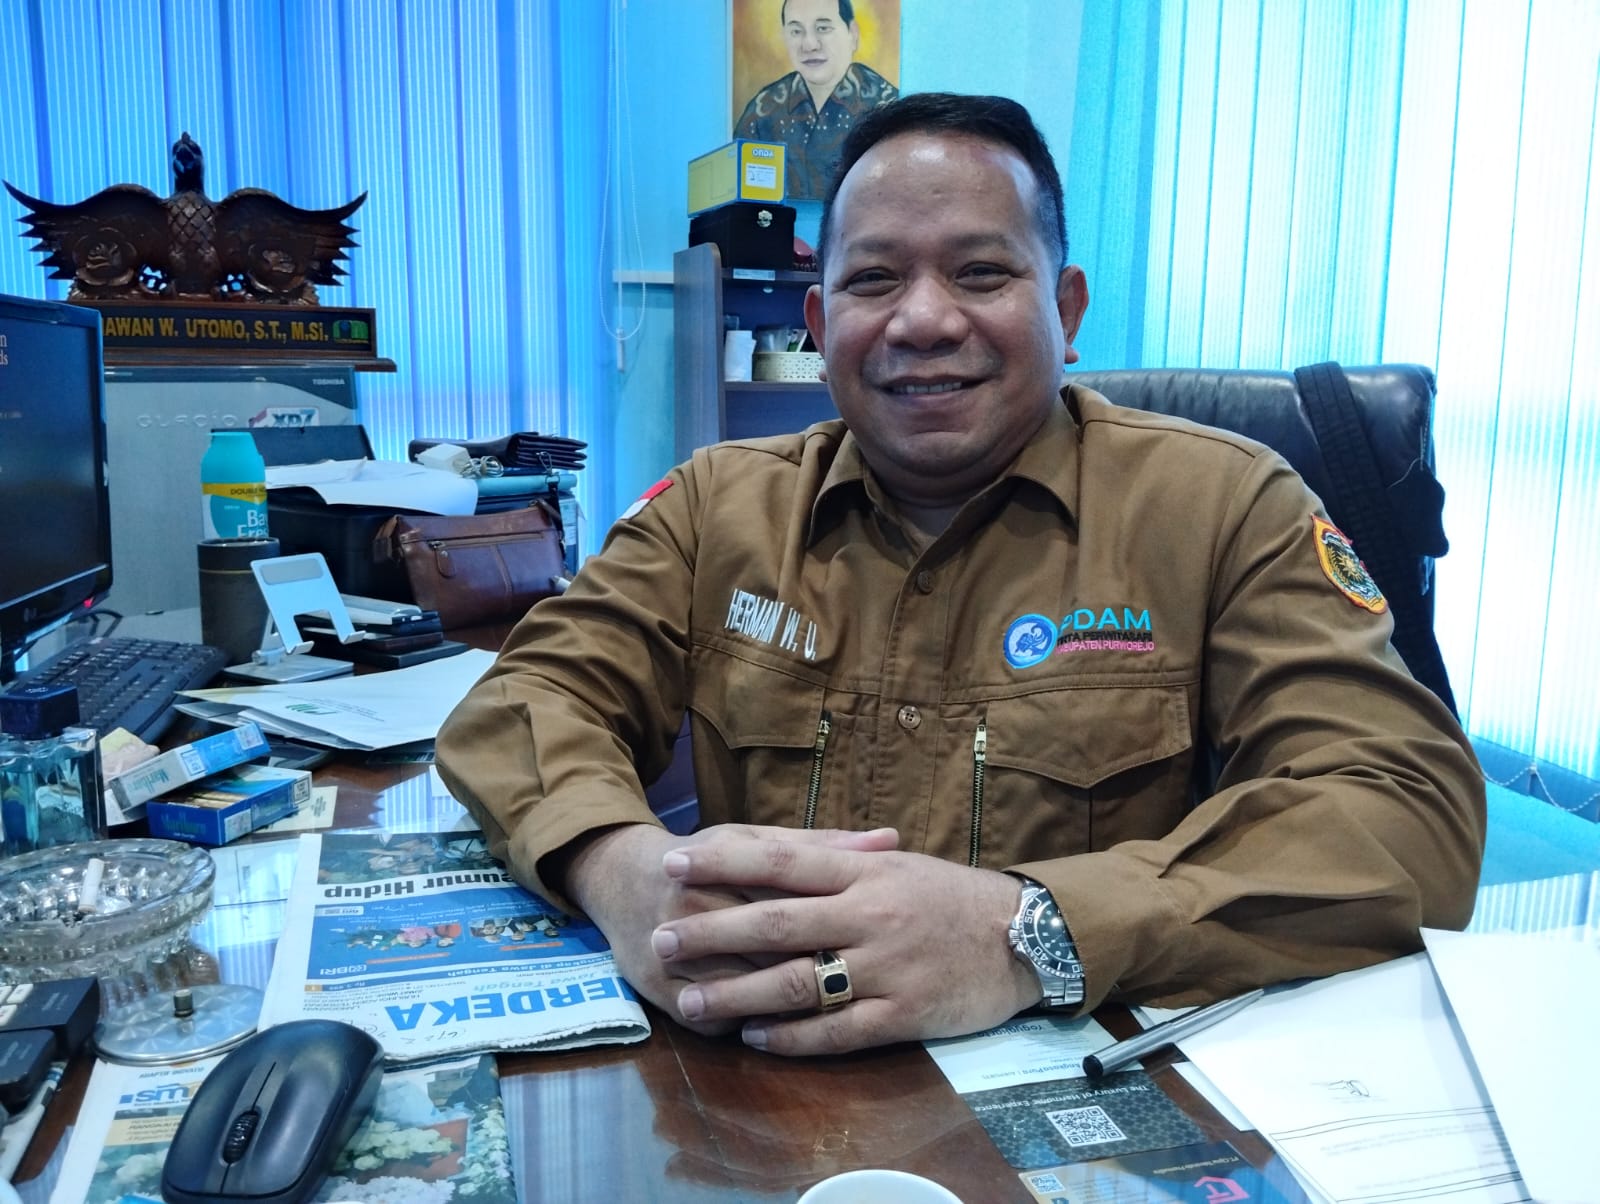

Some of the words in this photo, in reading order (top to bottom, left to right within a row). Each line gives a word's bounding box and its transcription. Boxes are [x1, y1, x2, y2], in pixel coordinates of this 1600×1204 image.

[158, 317, 179, 337] W.
[185, 318, 250, 343] UTOMO,
[724, 588, 785, 645] HERMAN
[323, 880, 414, 900] Hidup
